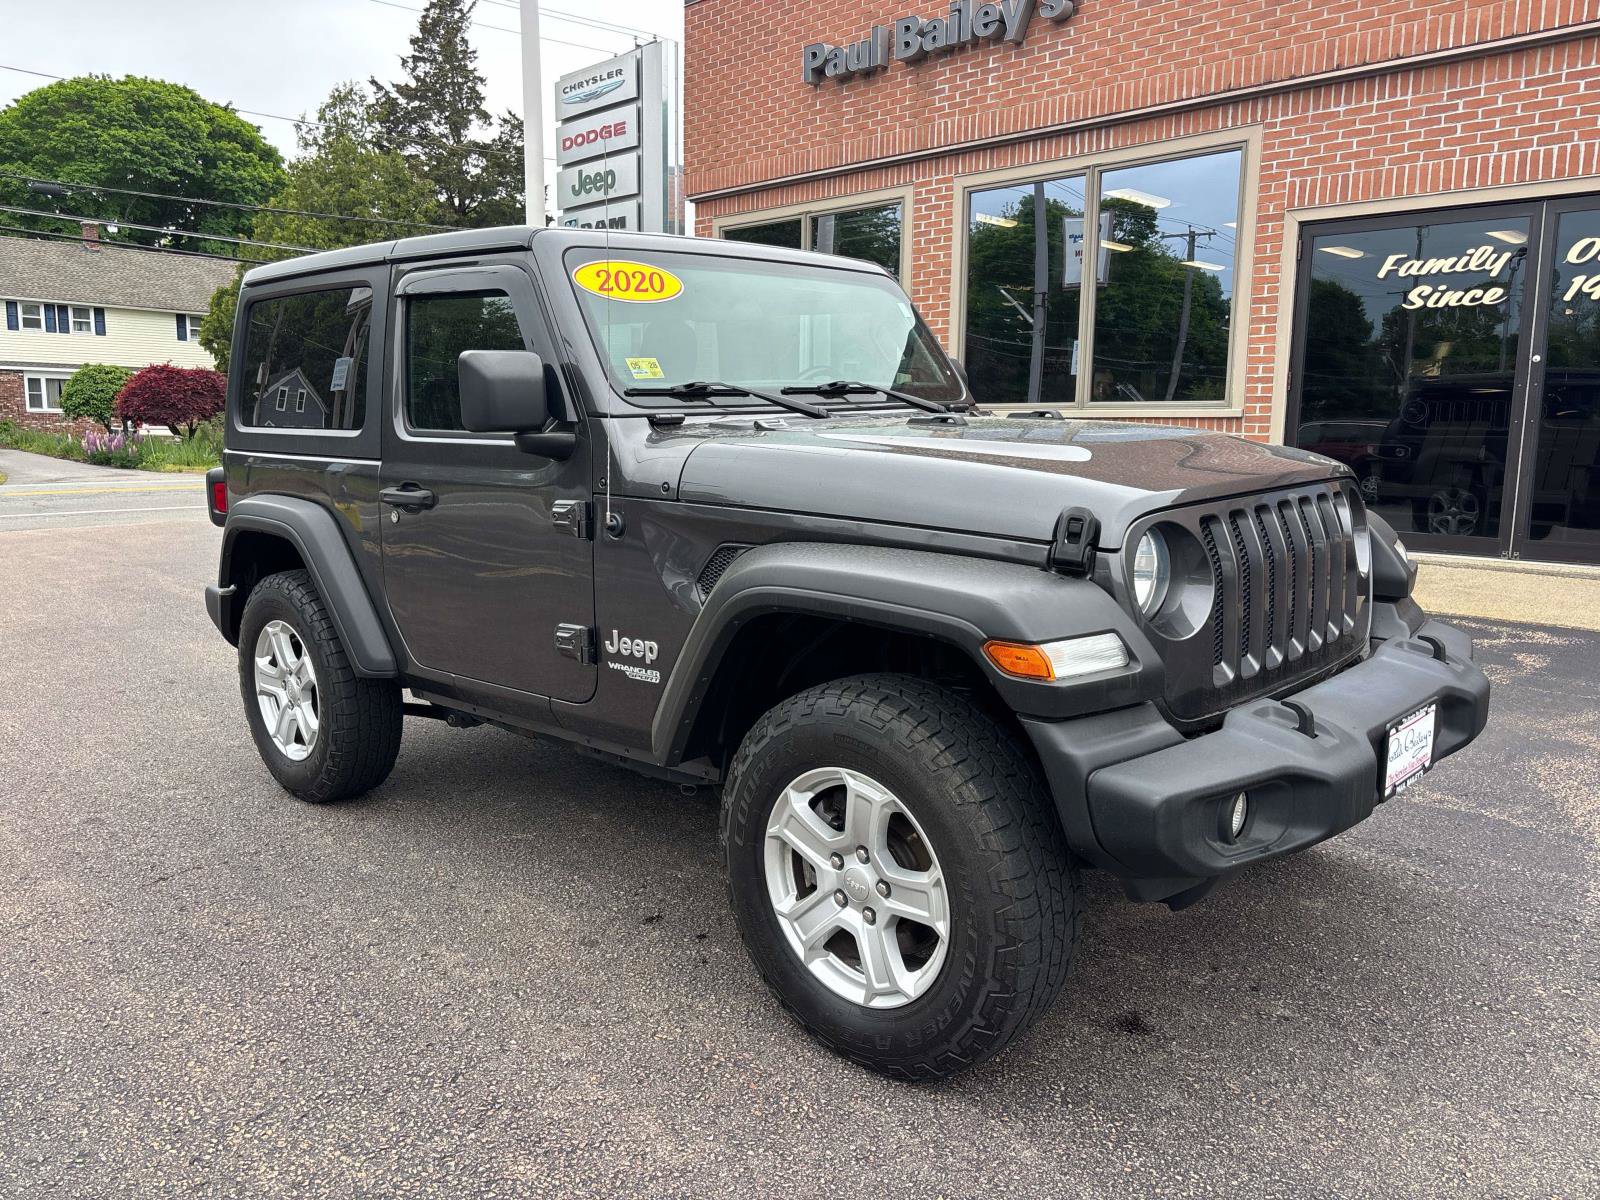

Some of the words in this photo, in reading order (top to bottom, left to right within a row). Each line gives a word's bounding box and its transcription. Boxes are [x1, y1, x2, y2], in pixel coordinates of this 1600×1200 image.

[804, 25, 888, 83] Paul
[895, 0, 1072, 60] Baileys
[562, 68, 623, 95] CHRYSLER
[562, 120, 627, 151] DODGE
[571, 169, 616, 196] Jeep
[1377, 246, 1512, 278] Family
[595, 269, 665, 293] 2020
[1402, 285, 1508, 309] Since
[605, 629, 659, 664] Jeep
[608, 661, 660, 677] WRANGLER
